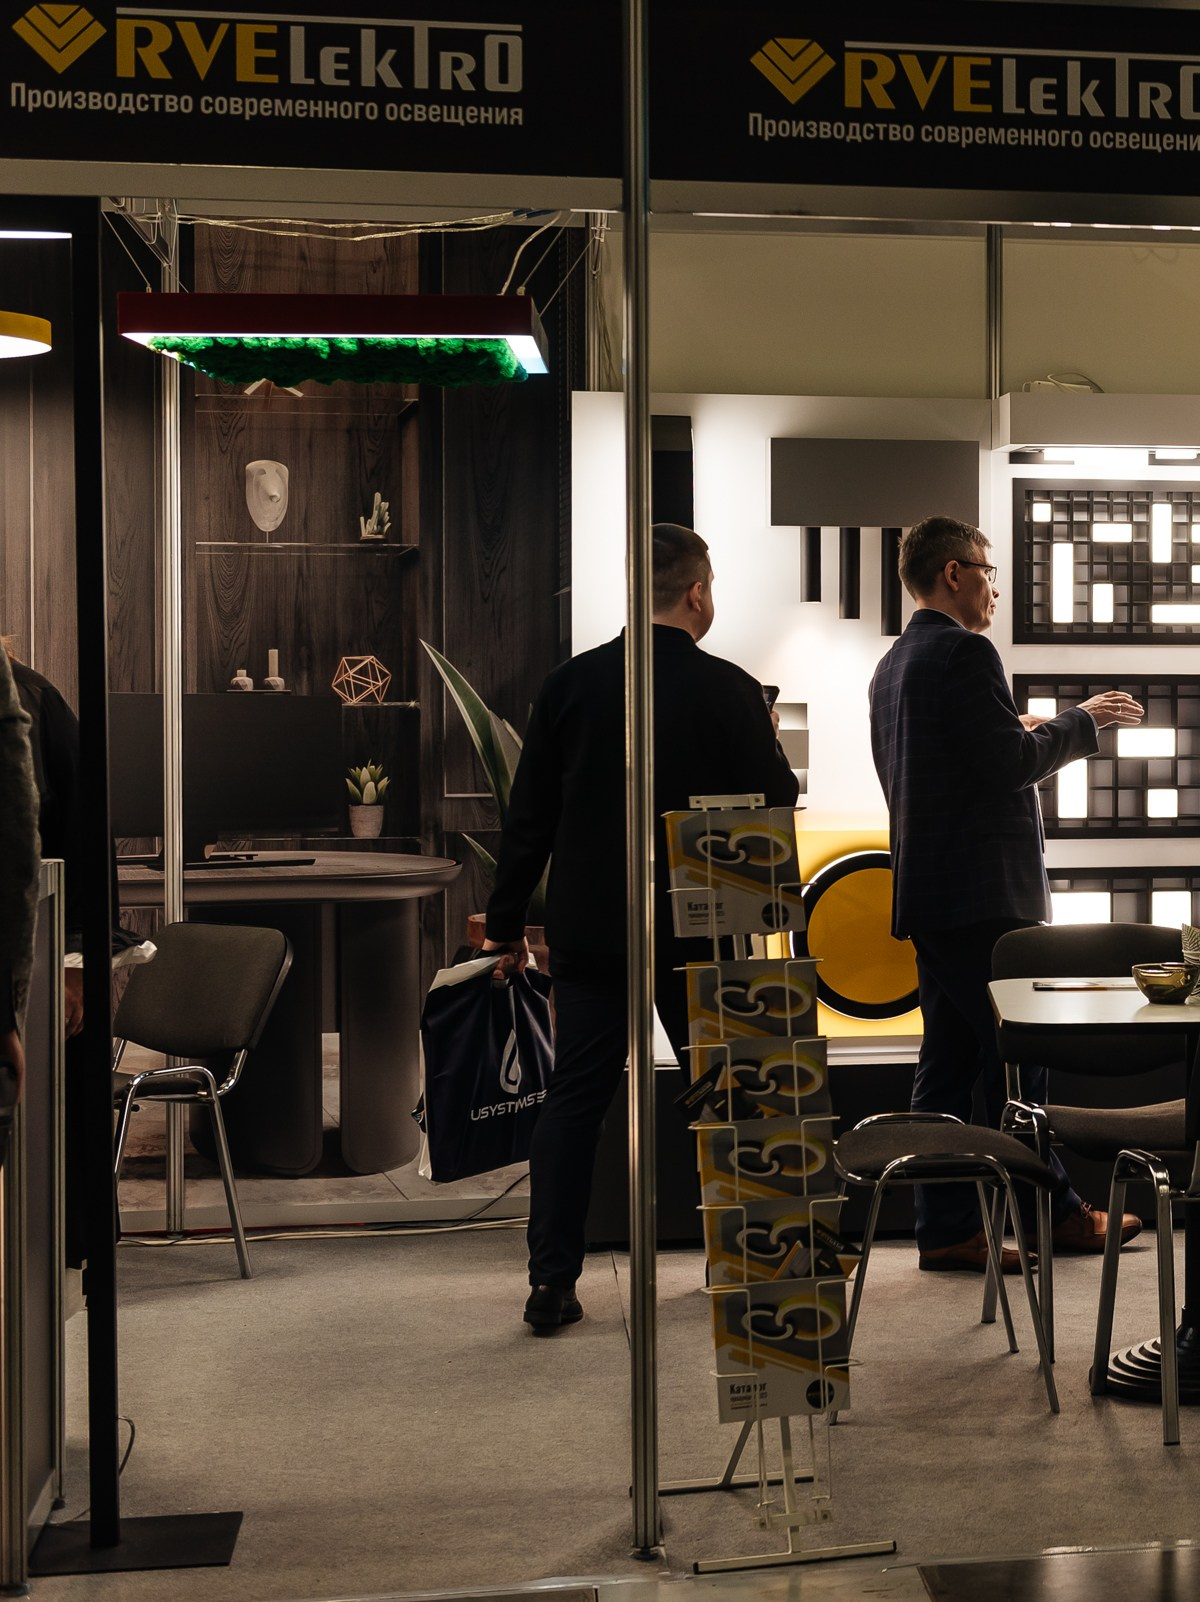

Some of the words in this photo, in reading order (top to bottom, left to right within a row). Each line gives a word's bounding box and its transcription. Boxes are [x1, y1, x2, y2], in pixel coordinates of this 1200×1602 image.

[10, 82, 193, 115] Производство
[200, 95, 378, 121] современного
[385, 102, 524, 127] освещения
[748, 112, 915, 143] Производство
[920, 124, 1083, 148] современного
[688, 902, 724, 911] Катаг
